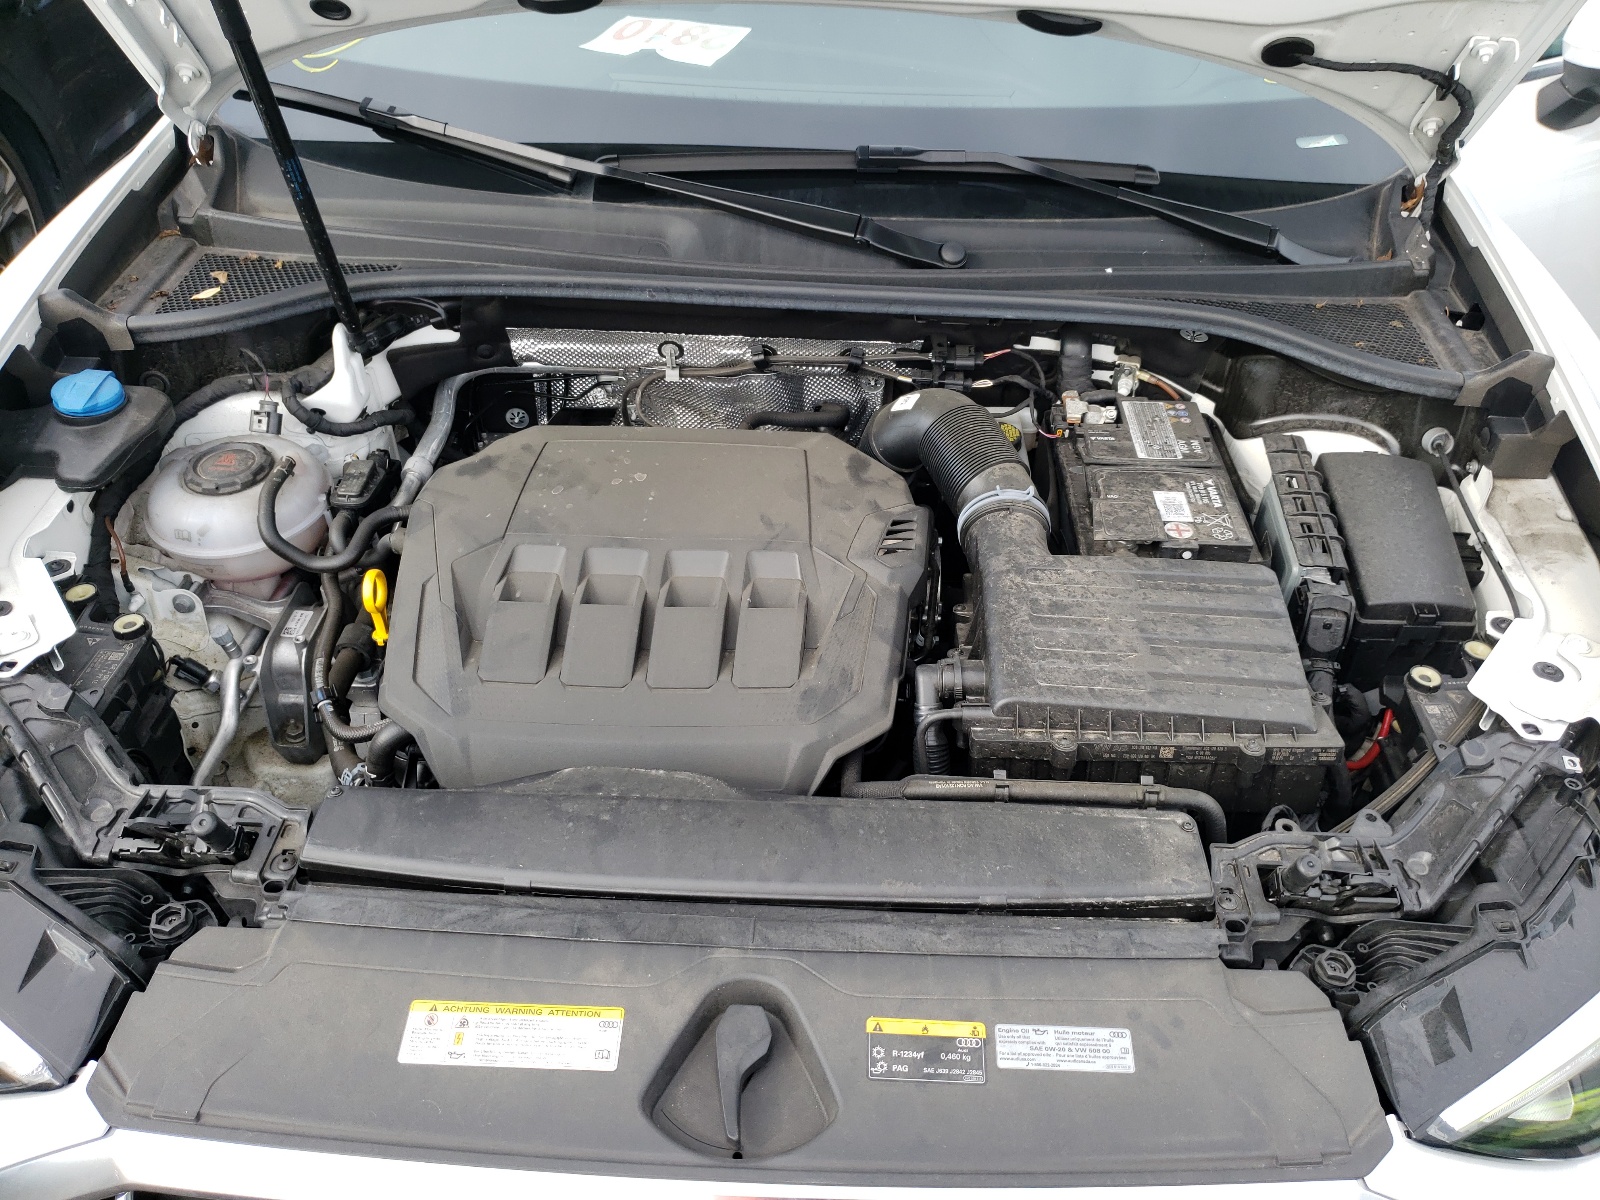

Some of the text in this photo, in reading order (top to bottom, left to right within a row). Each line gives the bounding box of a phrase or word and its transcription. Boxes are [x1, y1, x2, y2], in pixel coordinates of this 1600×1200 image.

[1206, 484, 1222, 508] VARTA
[495, 1007, 542, 1015] WARNING
[892, 1050, 924, 1059] R-1234yf
[961, 1054, 971, 1062] kg
[892, 1065, 908, 1073] PAG
